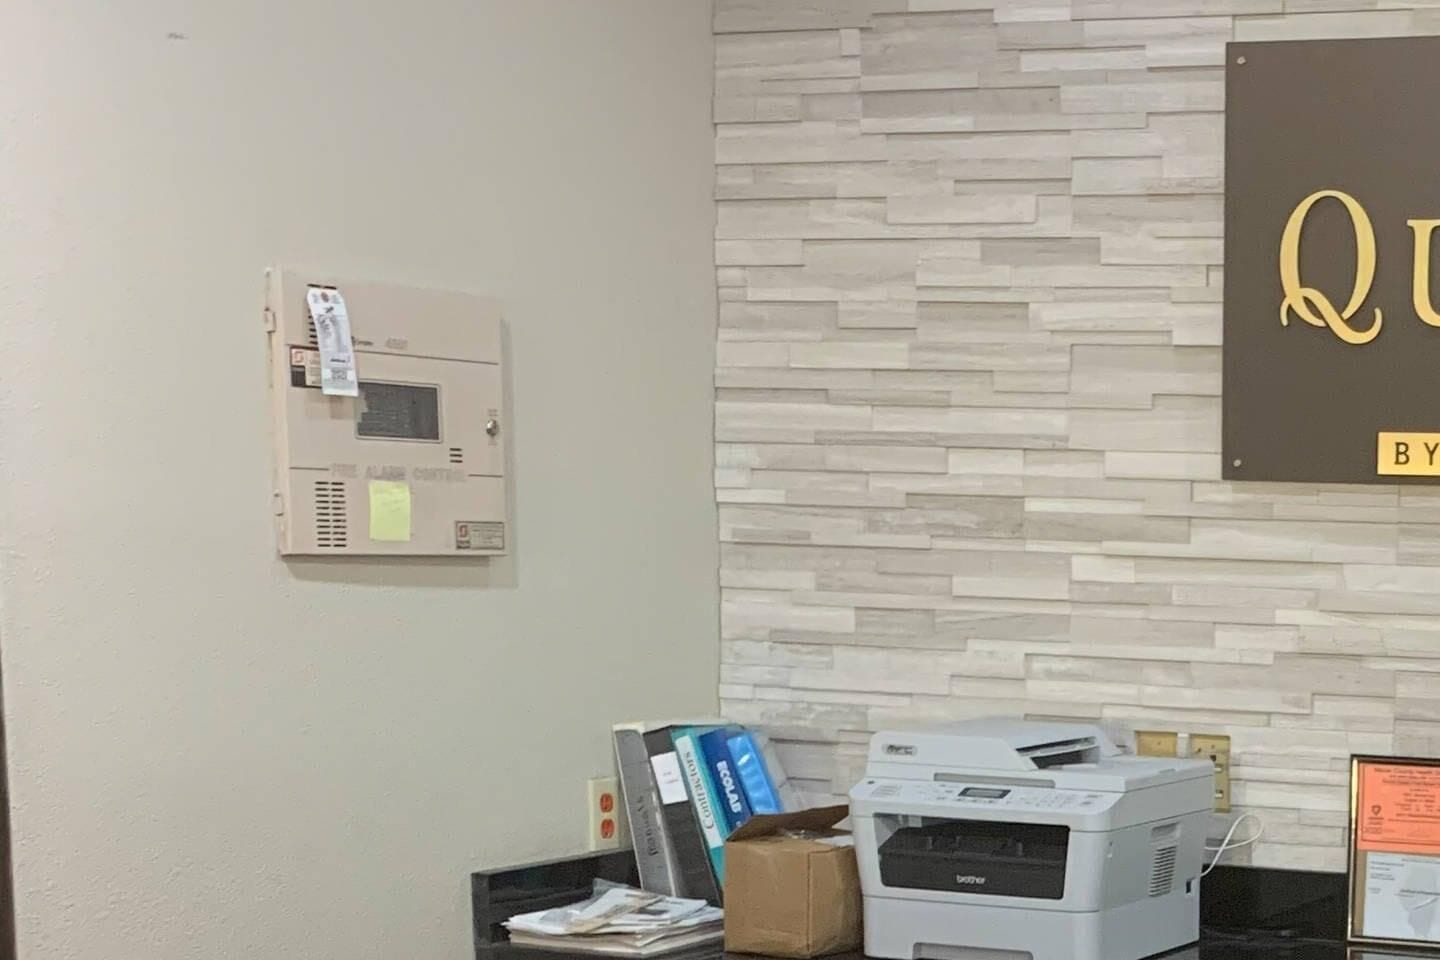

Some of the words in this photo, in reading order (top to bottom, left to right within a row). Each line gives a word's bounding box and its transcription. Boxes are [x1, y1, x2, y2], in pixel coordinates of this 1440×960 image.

[1393, 441, 1440, 466] BY
[686, 752, 714, 830] Contractors
[716, 760, 743, 814] ECOLAB
[956, 874, 986, 885] brother
